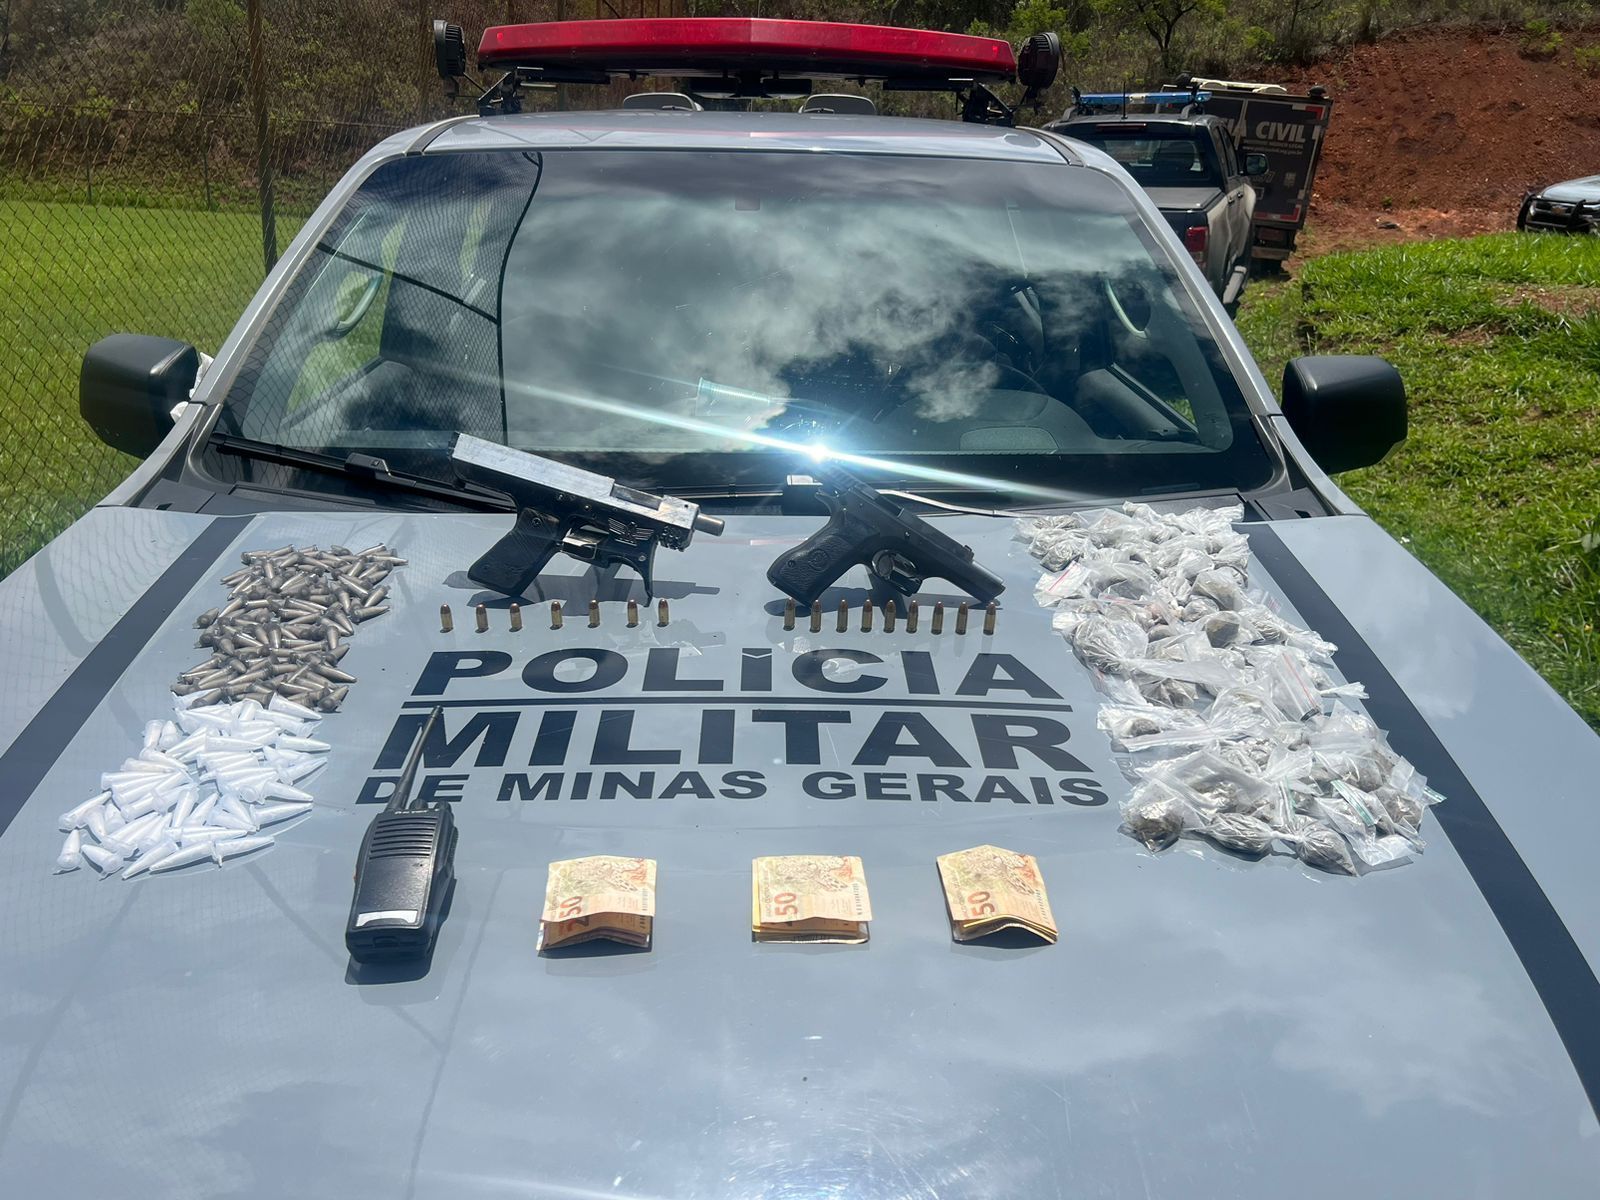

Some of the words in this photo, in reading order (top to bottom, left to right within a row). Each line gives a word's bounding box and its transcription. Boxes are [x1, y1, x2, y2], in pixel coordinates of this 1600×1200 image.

[1256, 121, 1306, 143] CIVIL
[373, 709, 1095, 773] MILITAR
[355, 774, 470, 805] DE
[496, 770, 767, 802] MINAS
[802, 771, 1110, 807] GERAIS
[559, 896, 583, 919] 50
[774, 892, 798, 916] 50
[967, 891, 996, 916] 50
